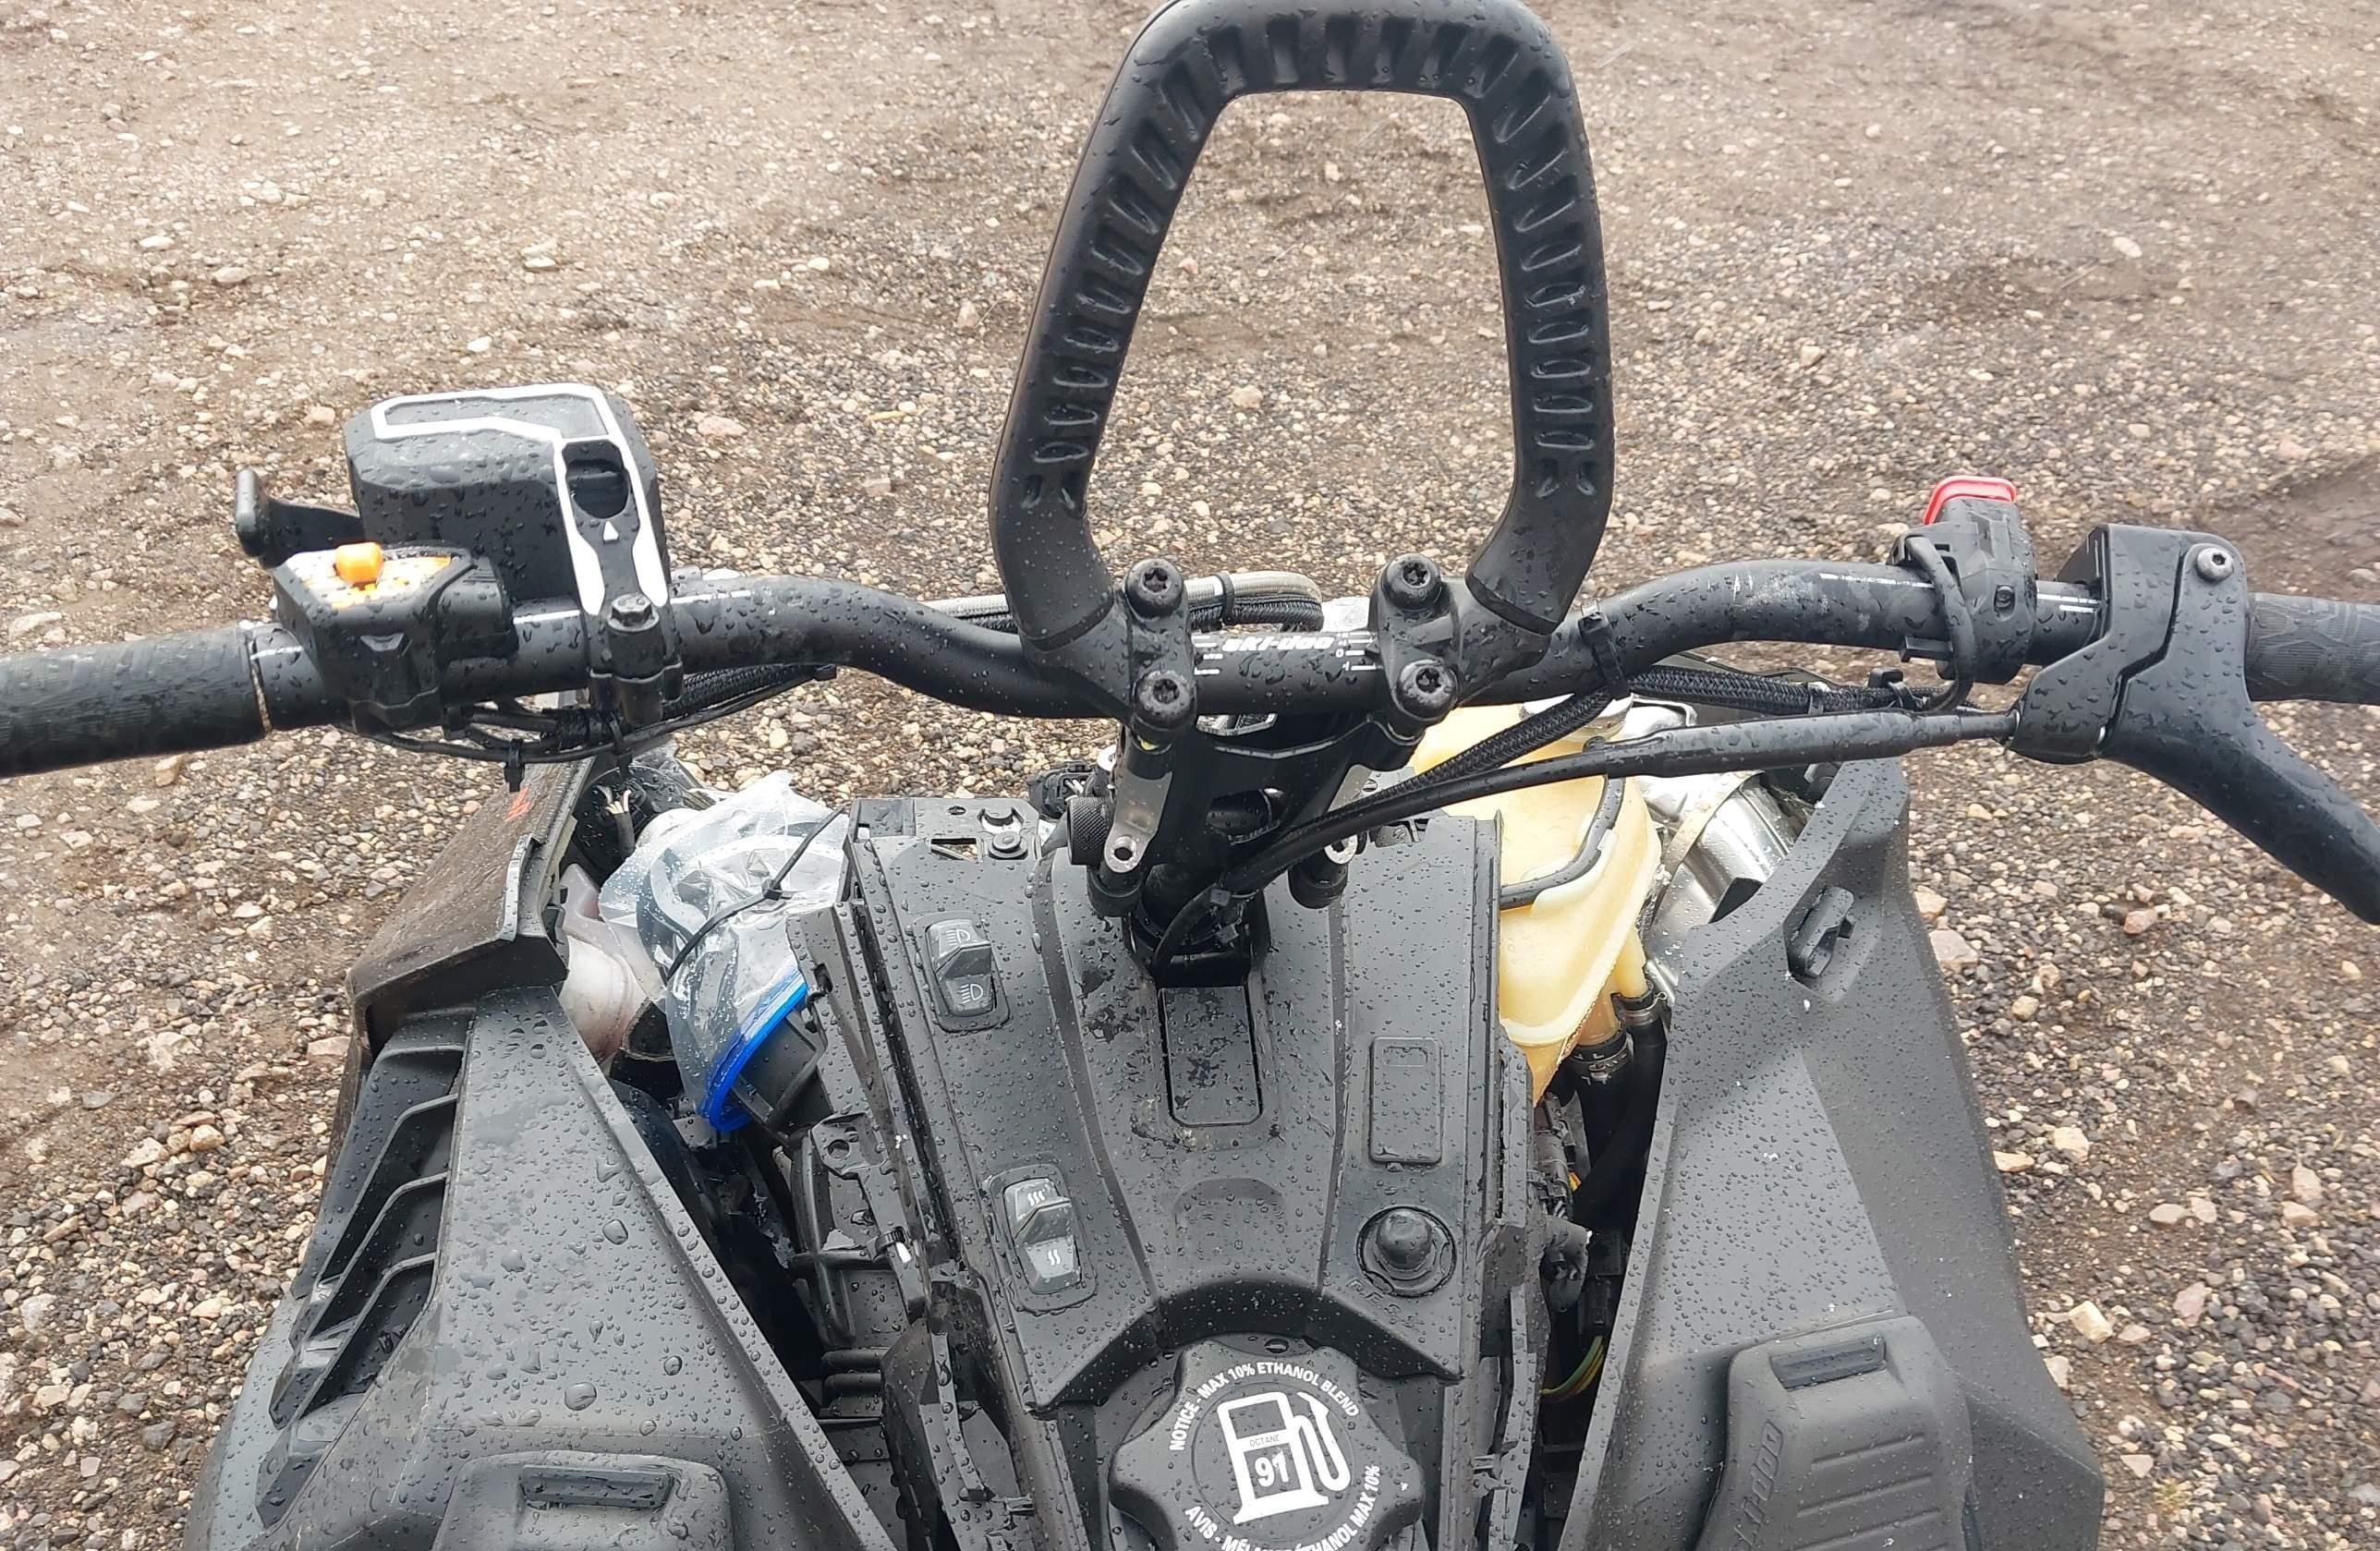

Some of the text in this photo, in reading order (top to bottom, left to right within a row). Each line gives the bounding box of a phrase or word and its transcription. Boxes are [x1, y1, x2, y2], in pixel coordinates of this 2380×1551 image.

[1169, 1400, 1200, 1452] NOTICE
[1196, 1372, 1231, 1400] MAX
[1227, 1363, 1256, 1381] 10%
[1257, 1362, 1319, 1387] ETHANOL
[1320, 1379, 1359, 1417] BLEND
[1249, 1433, 1281, 1448] OCTANE
[1254, 1448, 1290, 1487] 91
[1184, 1506, 1218, 1539] AVIS
[1349, 1491, 1377, 1529] MAX
[1364, 1463, 1380, 1493] 10%
